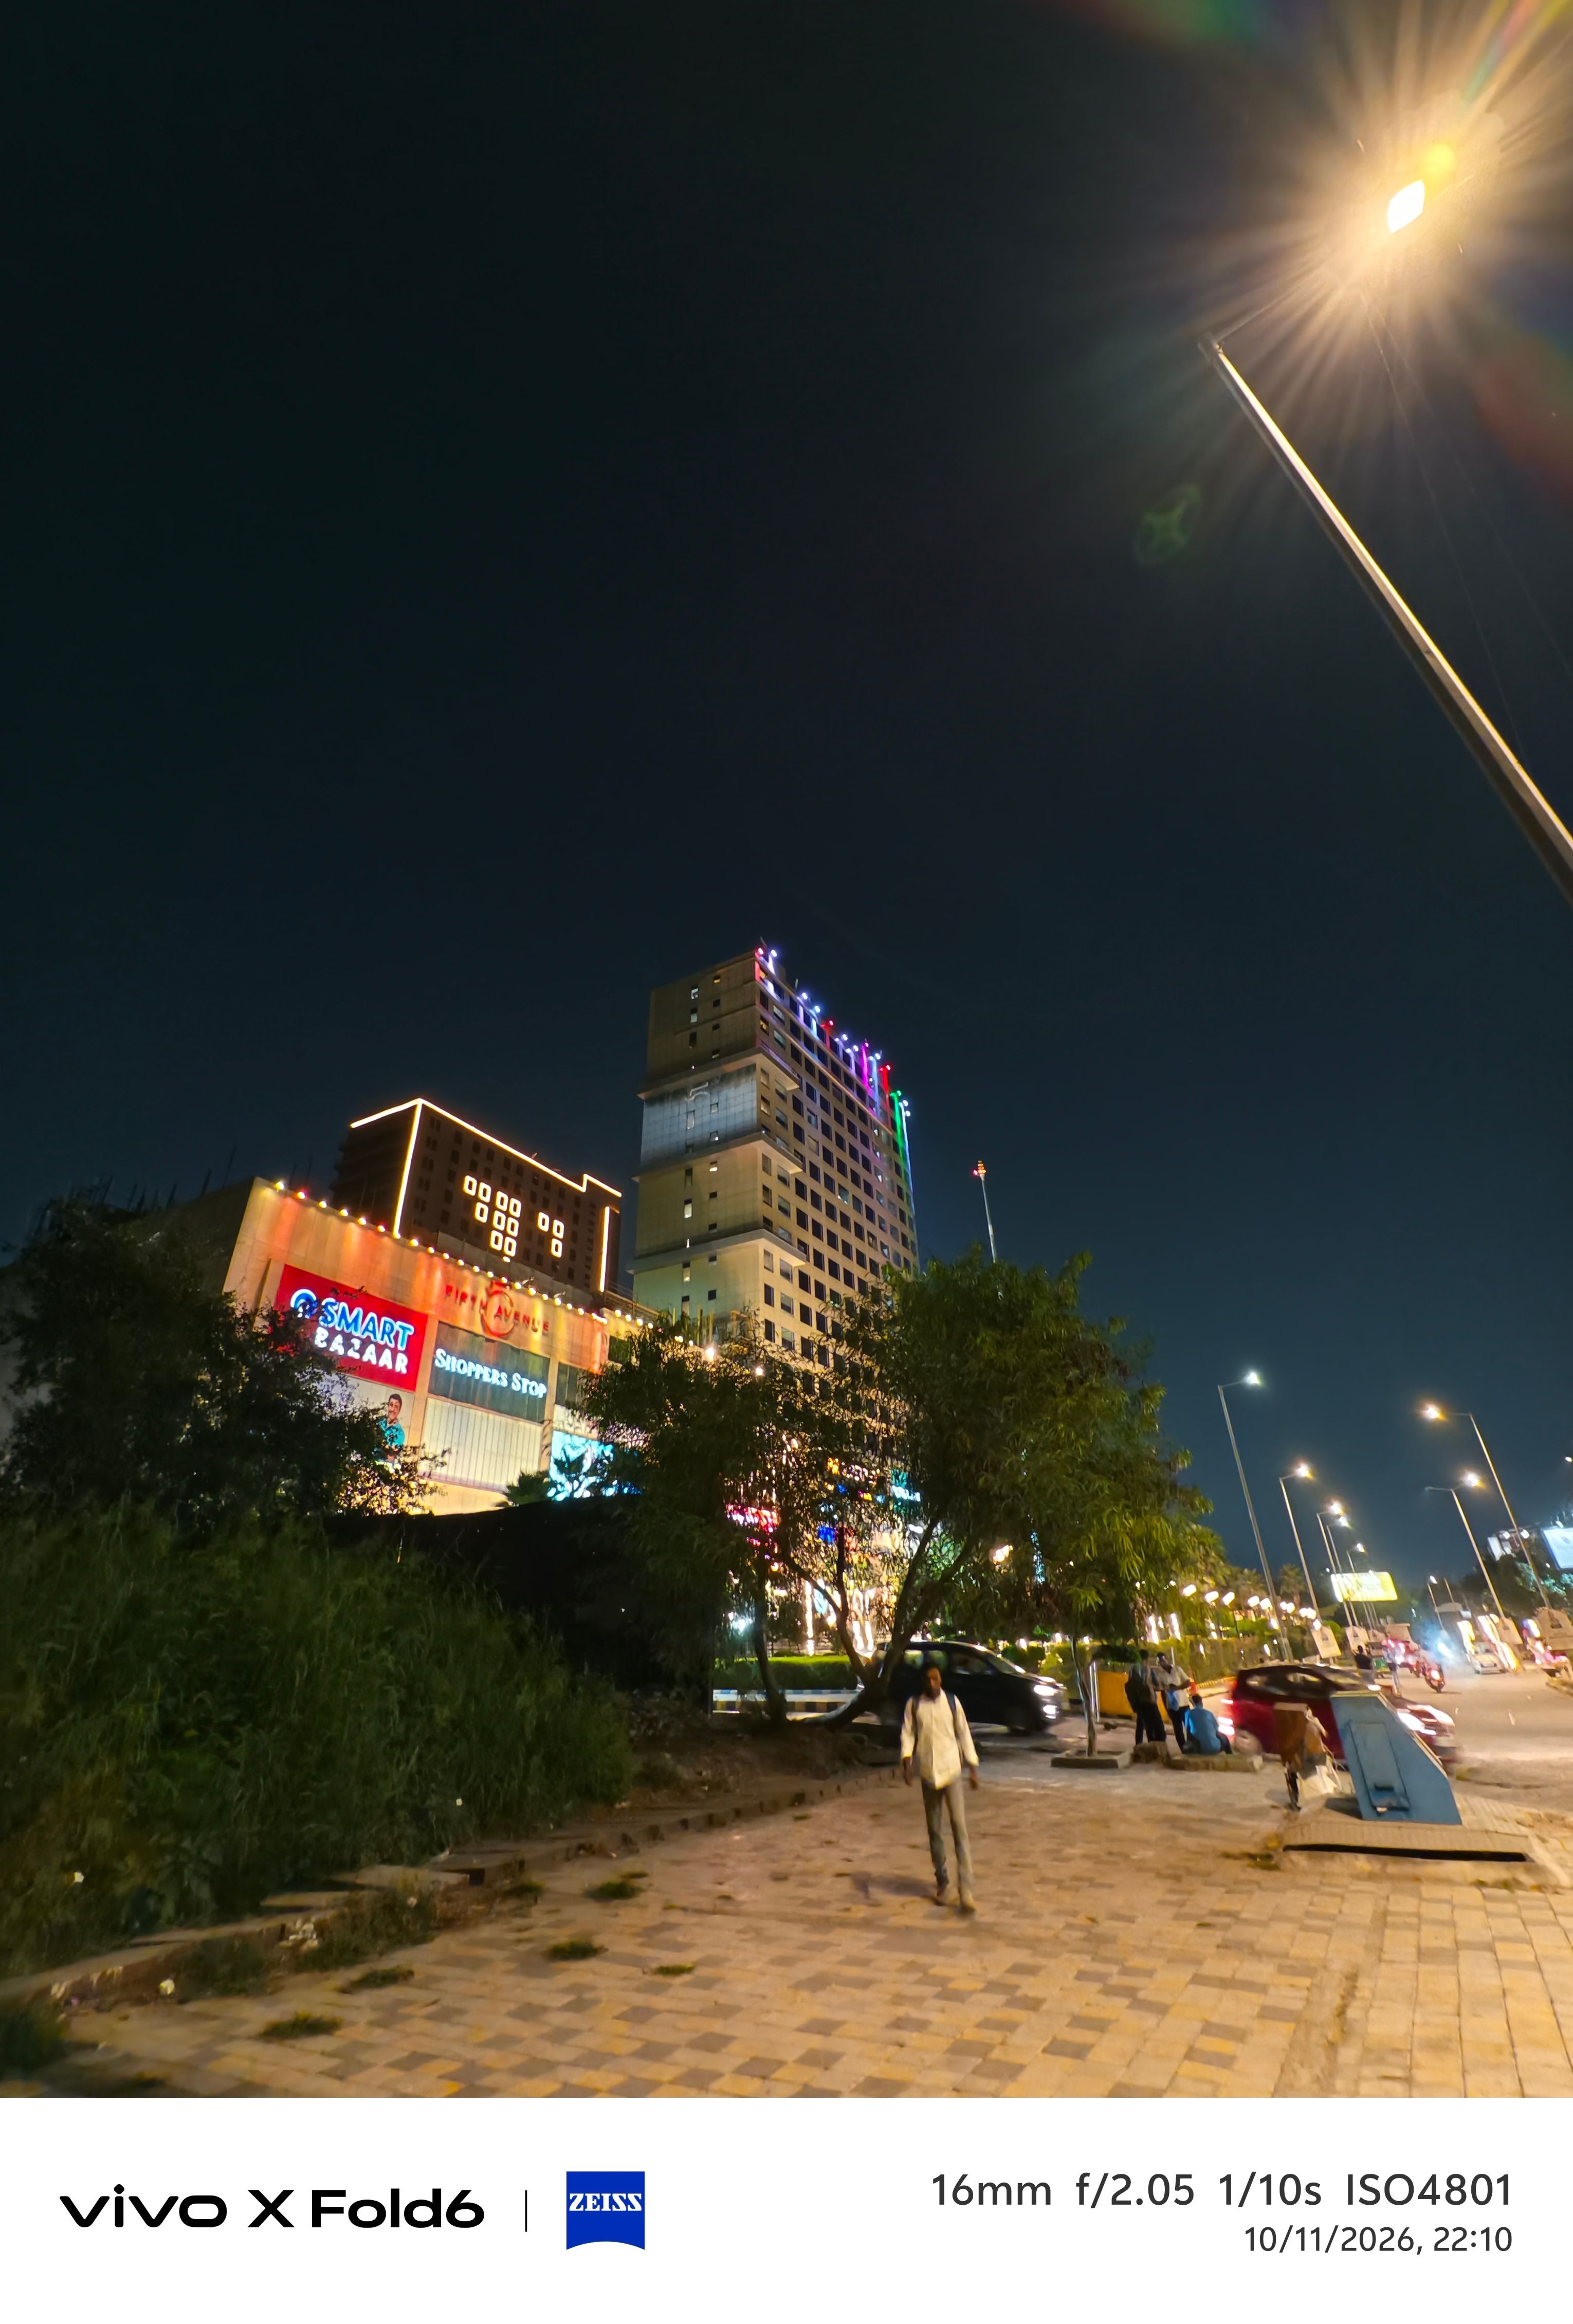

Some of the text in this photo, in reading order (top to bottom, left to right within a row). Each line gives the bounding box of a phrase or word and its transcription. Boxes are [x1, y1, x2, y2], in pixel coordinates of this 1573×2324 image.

[319, 1297, 414, 1351] SMART
[493, 1304, 550, 1334] AVENUE
[314, 1327, 408, 1374] BAZAAR
